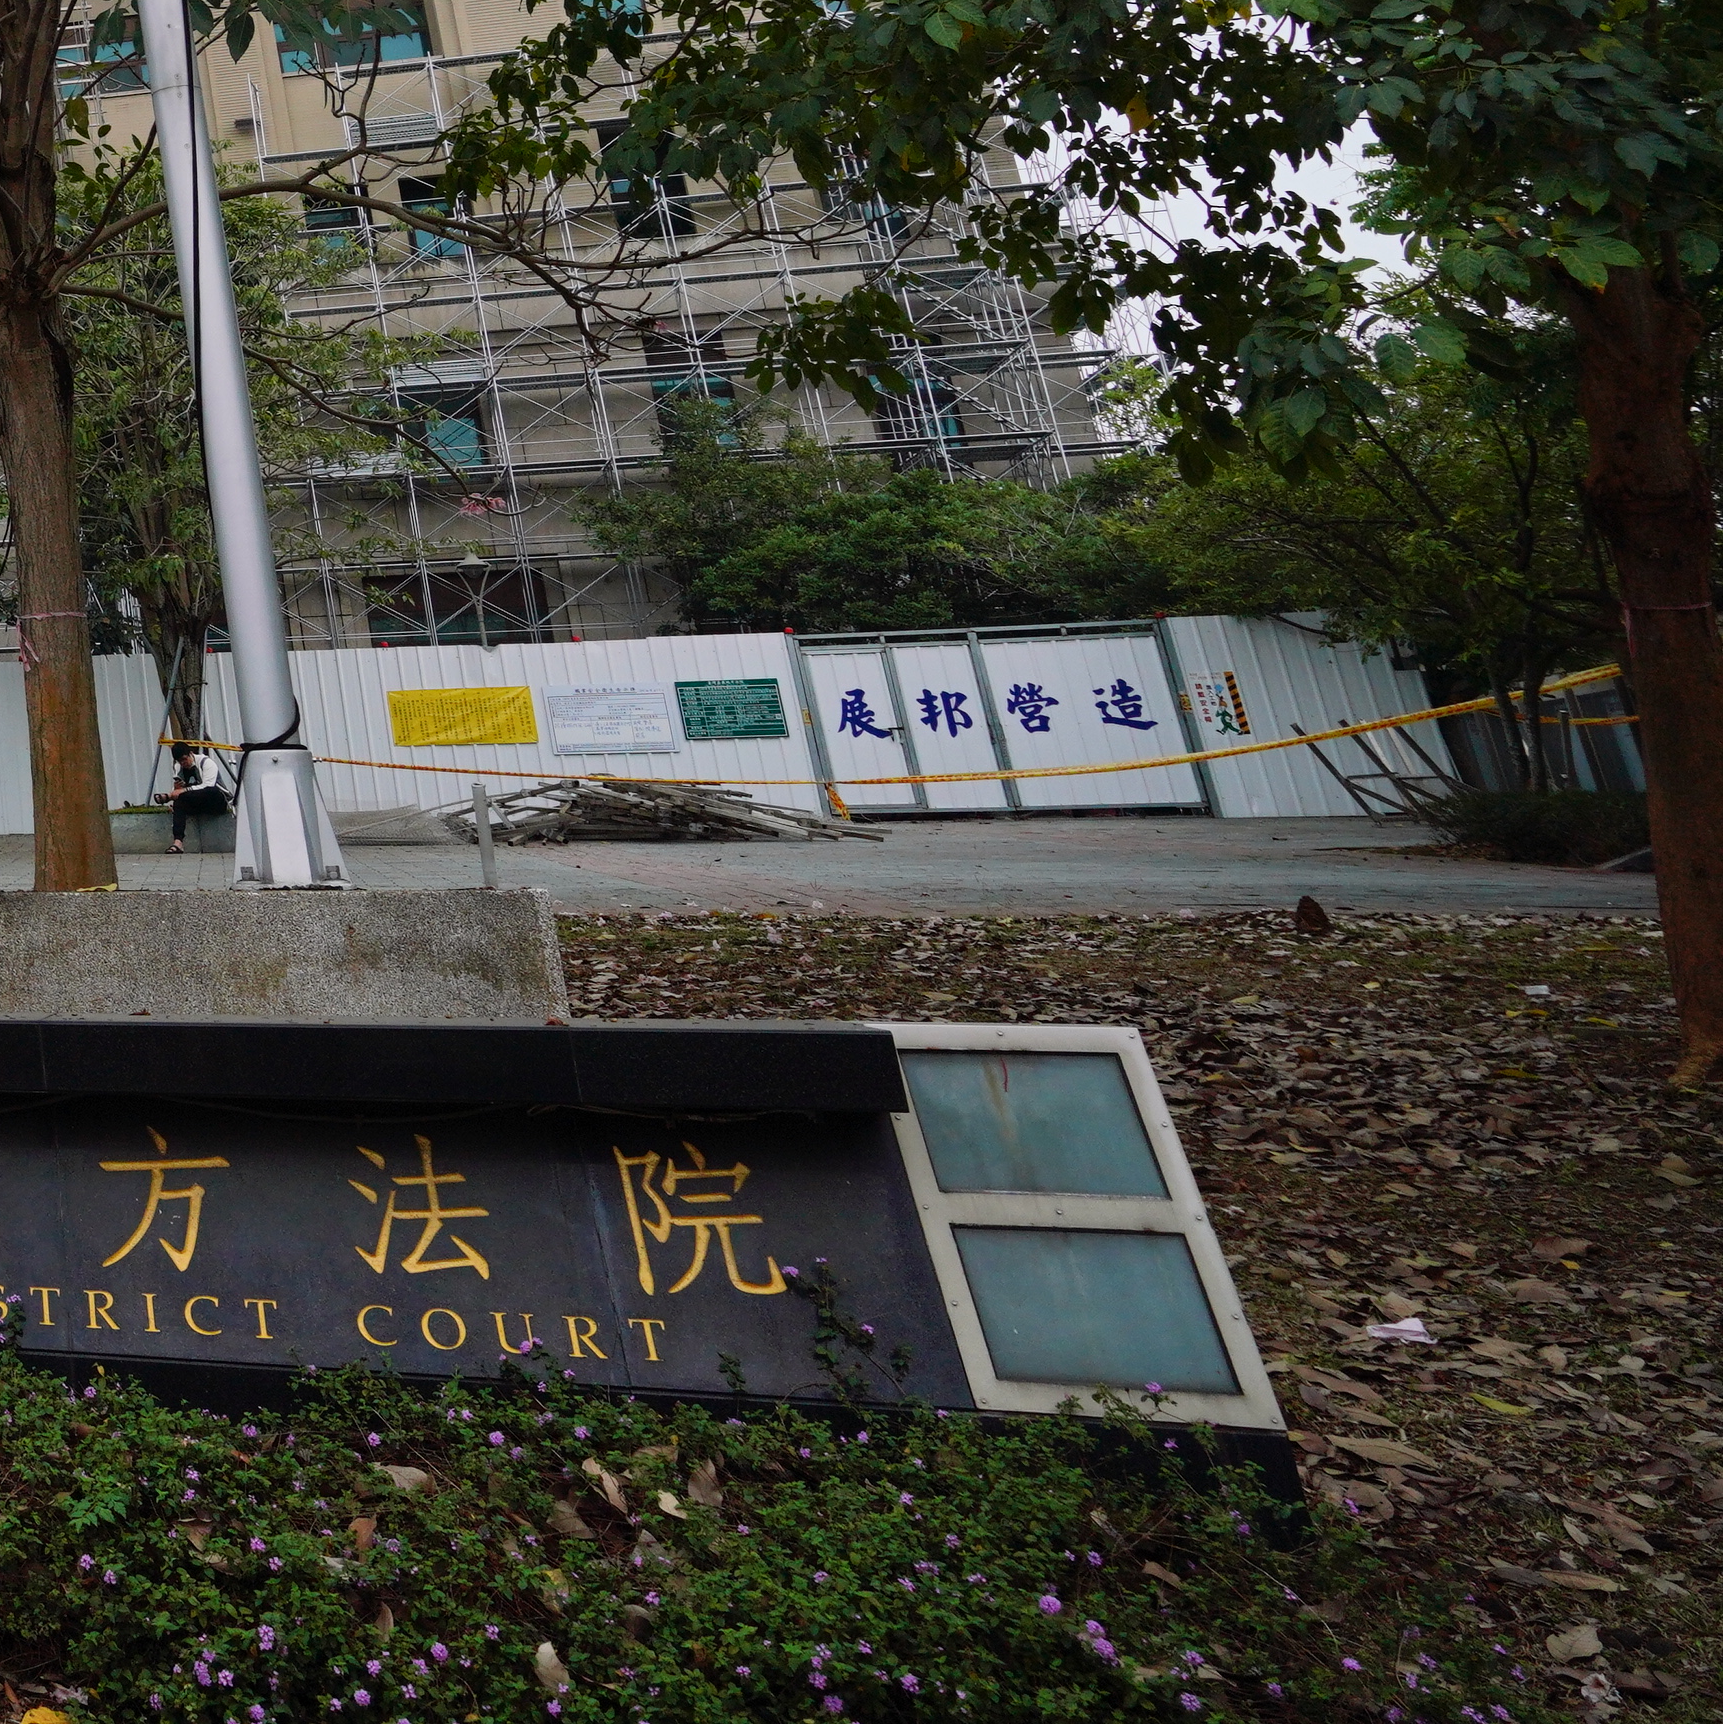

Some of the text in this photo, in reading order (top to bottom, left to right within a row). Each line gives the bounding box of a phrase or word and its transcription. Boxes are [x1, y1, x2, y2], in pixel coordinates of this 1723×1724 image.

[838, 678, 1158, 739] 展邦營造
[357, 1304, 666, 1362] COURT
